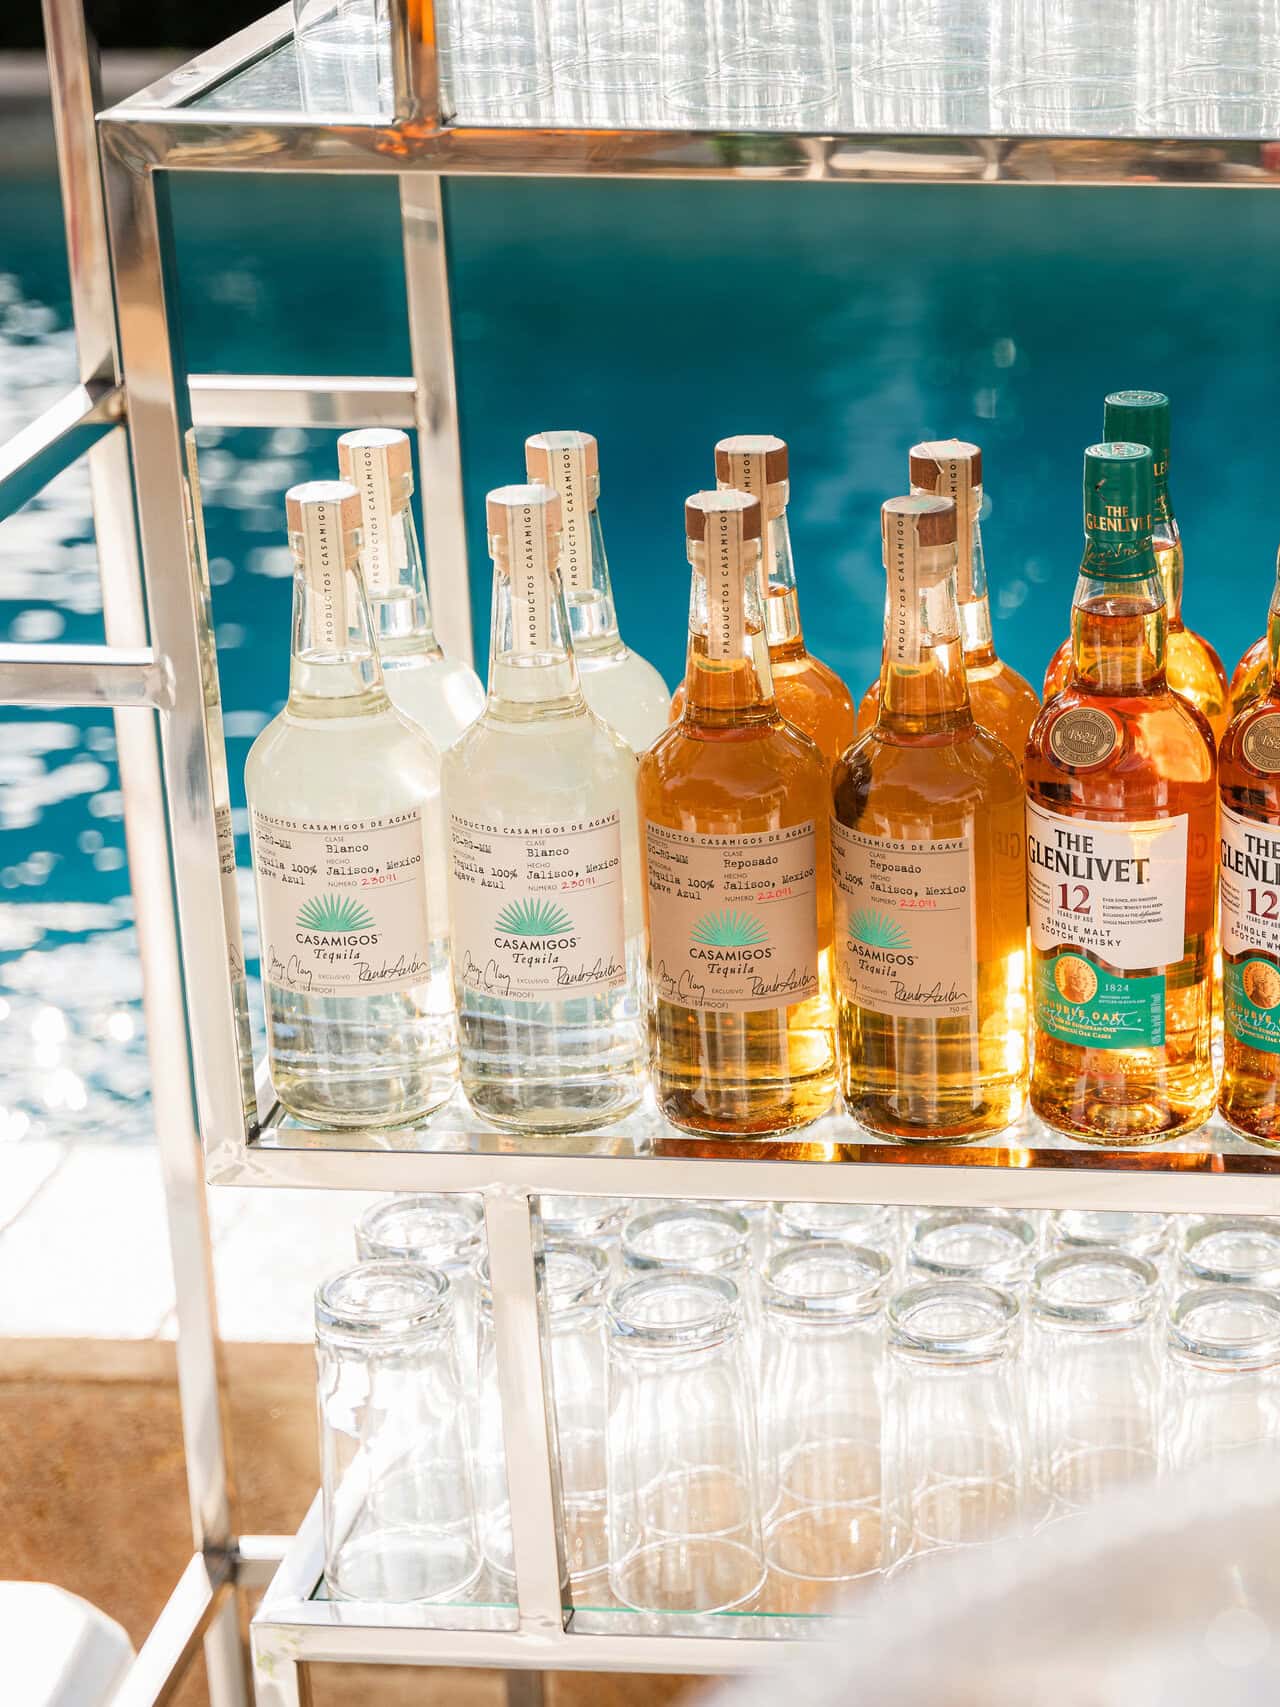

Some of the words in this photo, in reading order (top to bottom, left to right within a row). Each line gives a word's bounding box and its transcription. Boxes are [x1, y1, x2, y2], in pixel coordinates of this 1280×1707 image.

[563, 447, 573, 512] CASAMIGOS
[1105, 505, 1128, 517] THE
[569, 519, 577, 586] PRODUCTOS
[324, 572, 333, 642] PRODUCTOS
[528, 576, 536, 645] PRODUCTOS
[302, 823, 365, 831] CASAMIGOS
[388, 812, 417, 825] AGAVE
[589, 815, 616, 828] AGAVE
[701, 838, 763, 846] CASAMIGOS
[786, 825, 812, 838] AGAVE
[853, 835, 904, 850] CASAMIGOS
[931, 842, 963, 851] AGAVE
[1055, 829, 1094, 854] THE
[327, 845, 369, 853] Blanco
[527, 848, 569, 857] Blanco
[292, 864, 318, 875] 100%
[386, 855, 421, 870] Mexico
[586, 857, 619, 873] Mexico
[724, 856, 778, 869] Reposado
[870, 860, 922, 873] Reposado
[491, 868, 518, 879] 100%
[782, 868, 814, 884] Mexico
[845, 872, 863, 887] 100%
[687, 879, 715, 891] 100%
[926, 885, 966, 895] Mexico
[1058, 883, 1091, 914] 12
[1248, 888, 1279, 920] 12
[1047, 917, 1079, 933] SINGLE
[1084, 927, 1111, 937] MALT
[1236, 922, 1267, 938] SINGLE
[296, 933, 378, 946] CASAMIGOS
[1041, 923, 1074, 942] SCOTCH
[1079, 937, 1121, 947] WHISKY
[1231, 928, 1262, 948] SCOTCH
[495, 938, 577, 950] CASAMIGOS
[314, 949, 360, 960] Tequila
[512, 953, 559, 967] Tequila
[690, 948, 772, 960] CASAMIGOS
[847, 941, 914, 966] CASAMIGOS
[708, 963, 754, 978] Tequila
[859, 959, 897, 977] Tequila
[1105, 984, 1129, 992] 1824
